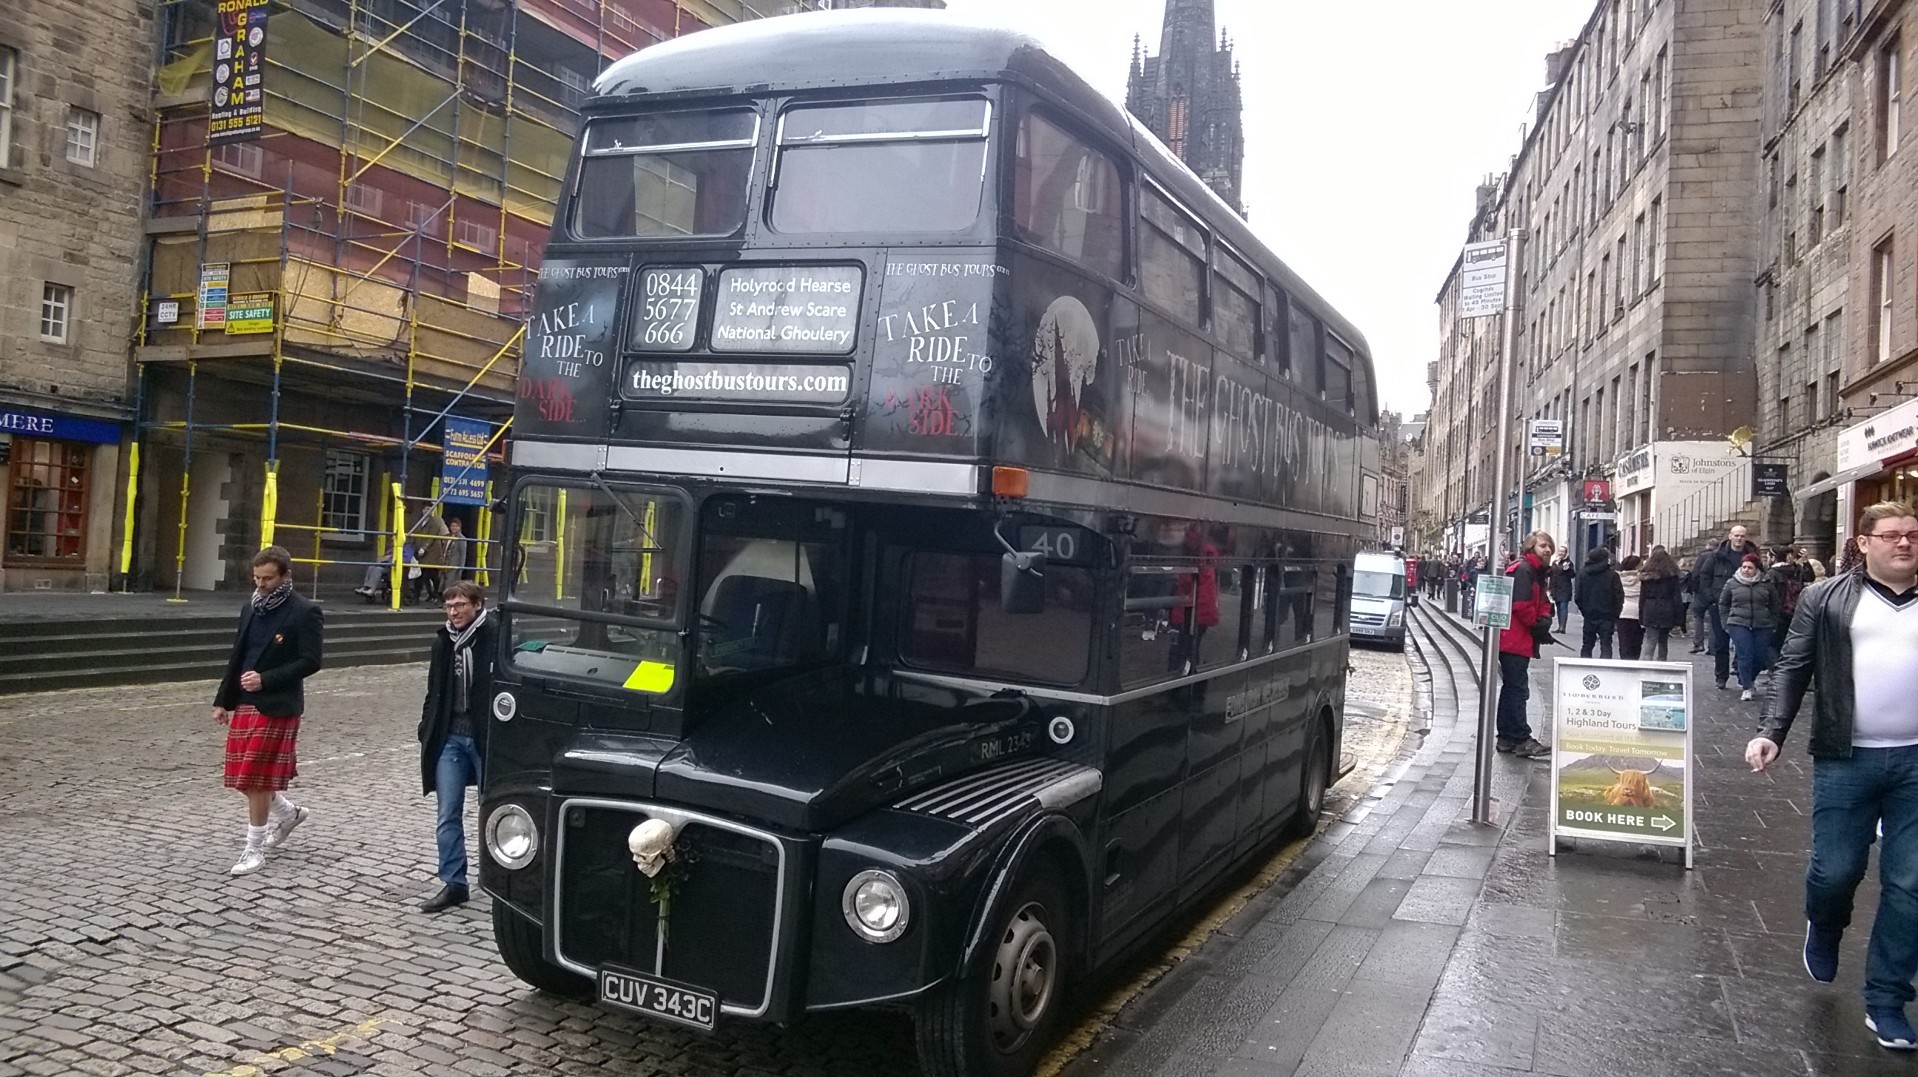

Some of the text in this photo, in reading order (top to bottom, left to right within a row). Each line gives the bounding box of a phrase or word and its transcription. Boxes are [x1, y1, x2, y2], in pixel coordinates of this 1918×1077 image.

[231, 13, 247, 105] GRAHAM
[211, 115, 261, 131] 0131 555 5121
[576, 267, 592, 279] BUS
[906, 263, 940, 277] GHOST
[940, 263, 961, 276] BUS
[646, 273, 698, 297] 0844
[730, 277, 851, 297] Holyrood Hearse
[1484, 290, 1504, 298] Limited
[228, 311, 243, 320] SITE
[245, 308, 271, 319] SAFETY
[644, 298, 697, 321] 5677
[729, 302, 847, 317] St Andrew Scare
[526, 302, 595, 339] TAKE A
[878, 300, 979, 341] TAKE A
[644, 322, 685, 344] 666
[717, 324, 851, 345] National Ghoulery
[540, 335, 604, 367] RIDE TO
[907, 336, 993, 373] RIDE TO
[557, 360, 582, 377] THE
[931, 365, 963, 385] THE
[521, 377, 574, 399] DARK
[633, 369, 847, 395] theghostbustours.com
[883, 384, 954, 411] DARK
[1165, 350, 1211, 459] THE
[1212, 374, 1273, 475] GHOST
[1273, 402, 1304, 483] BUS
[445, 450, 487, 462] SCAFFOLDG
[445, 458, 486, 469] CONTRATOR
[1693, 458, 1737, 468] Johnstons
[469, 479, 485, 488] 4699
[470, 490, 484, 498] 5657
[1031, 531, 1075, 560] 40
[1566, 717, 1637, 730] Highland Tours
[1597, 710, 1611, 718] Day
[1581, 732, 1614, 740] Scotland
[981, 739, 1006, 760] RML
[1566, 742, 1583, 750] Book
[1609, 745, 1630, 754] Travel
[1631, 747, 1668, 757] Tomorrow
[1566, 809, 1645, 827] BOOK HERE
[605, 976, 711, 1023] CUV 343C
